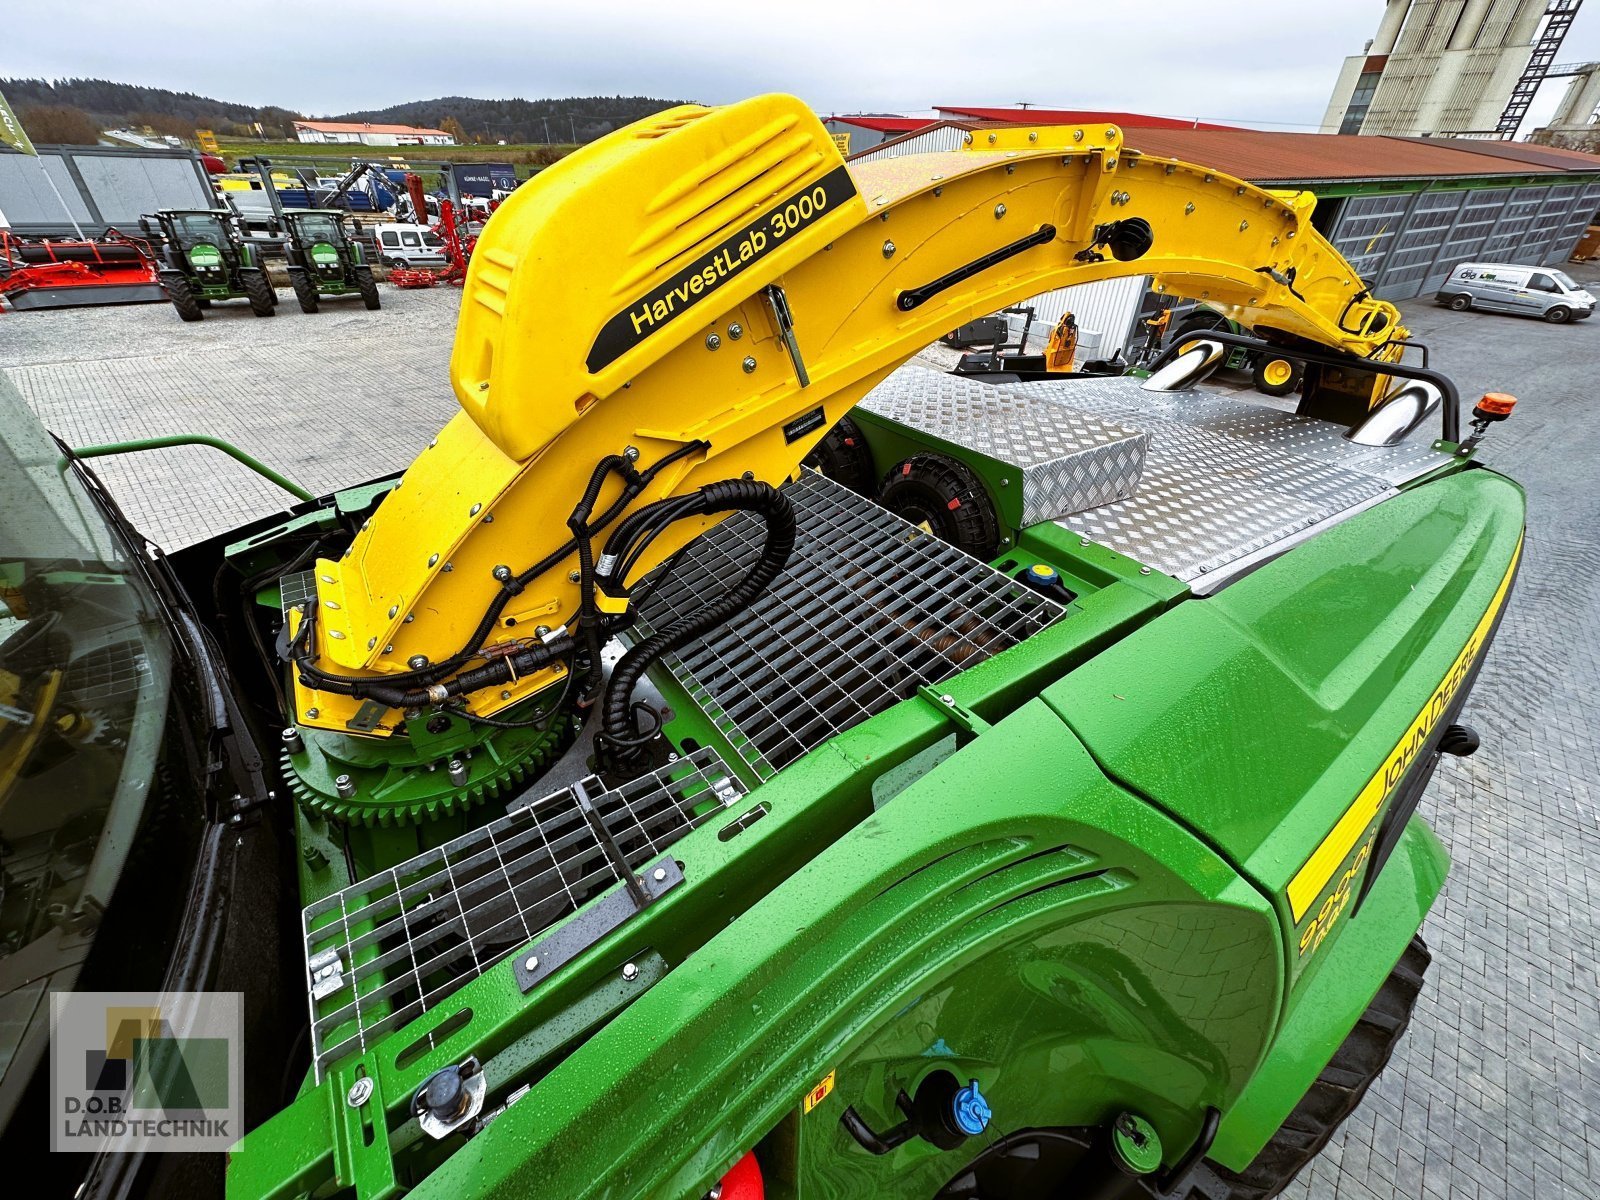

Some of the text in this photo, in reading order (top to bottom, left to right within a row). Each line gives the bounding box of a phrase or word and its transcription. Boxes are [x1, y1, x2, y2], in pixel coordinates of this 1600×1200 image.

[629, 186, 827, 335] HarvestLab 3000
[1376, 637, 1477, 809] JOHN DEERE
